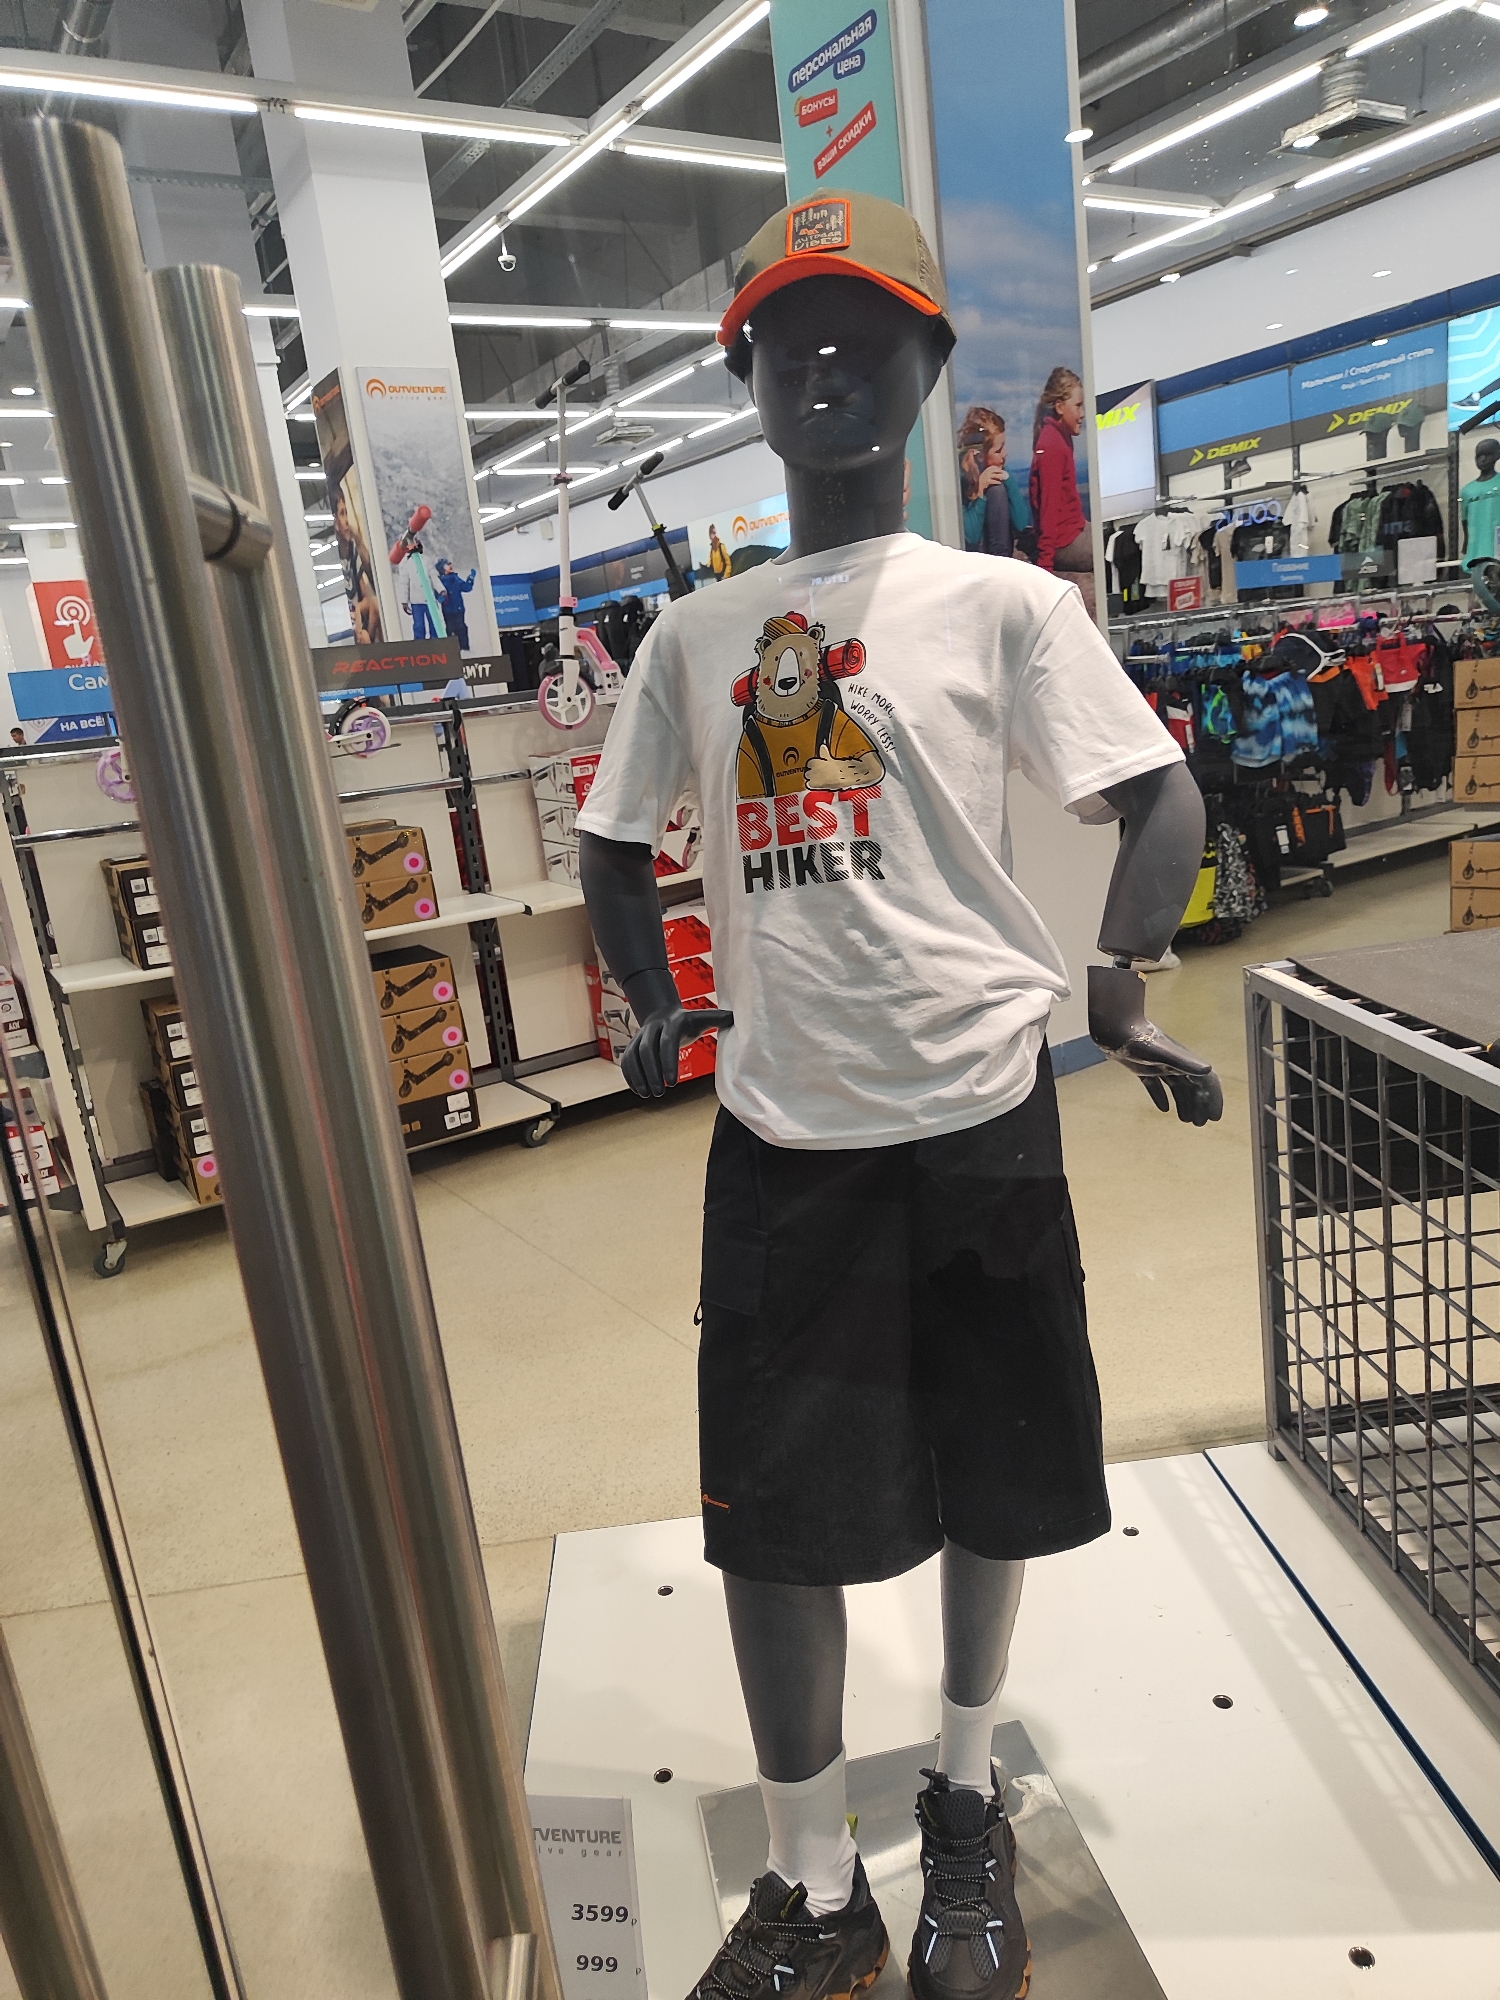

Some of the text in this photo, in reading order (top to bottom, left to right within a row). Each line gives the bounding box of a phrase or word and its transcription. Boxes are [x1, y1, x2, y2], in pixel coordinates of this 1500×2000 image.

[792, 15, 872, 87] персональная
[836, 54, 861, 75] цена
[801, 95, 836, 116] БОНУСЫ
[817, 110, 872, 171] ваши СКИДКИ
[388, 386, 446, 394] OUTVENTURE
[1096, 403, 1141, 430] MIX
[1206, 437, 1261, 460] DEMIX
[749, 512, 790, 531] OUTVENTU
[332, 653, 448, 675] REACTION
[69, 673, 109, 691] Сам
[848, 683, 895, 718] HIKE MORE,
[60, 722, 78, 732] НА
[850, 700, 896, 752] WORRY LESS!
[776, 767, 806, 777] OUTVENTU
[736, 785, 882, 852] BEST
[743, 840, 886, 894] HIKER
[533, 1828, 622, 1844] TVENTURE
[538, 1845, 623, 1858] ive gear
[571, 1904, 629, 1923] 3599
[576, 1955, 618, 1972] 999
